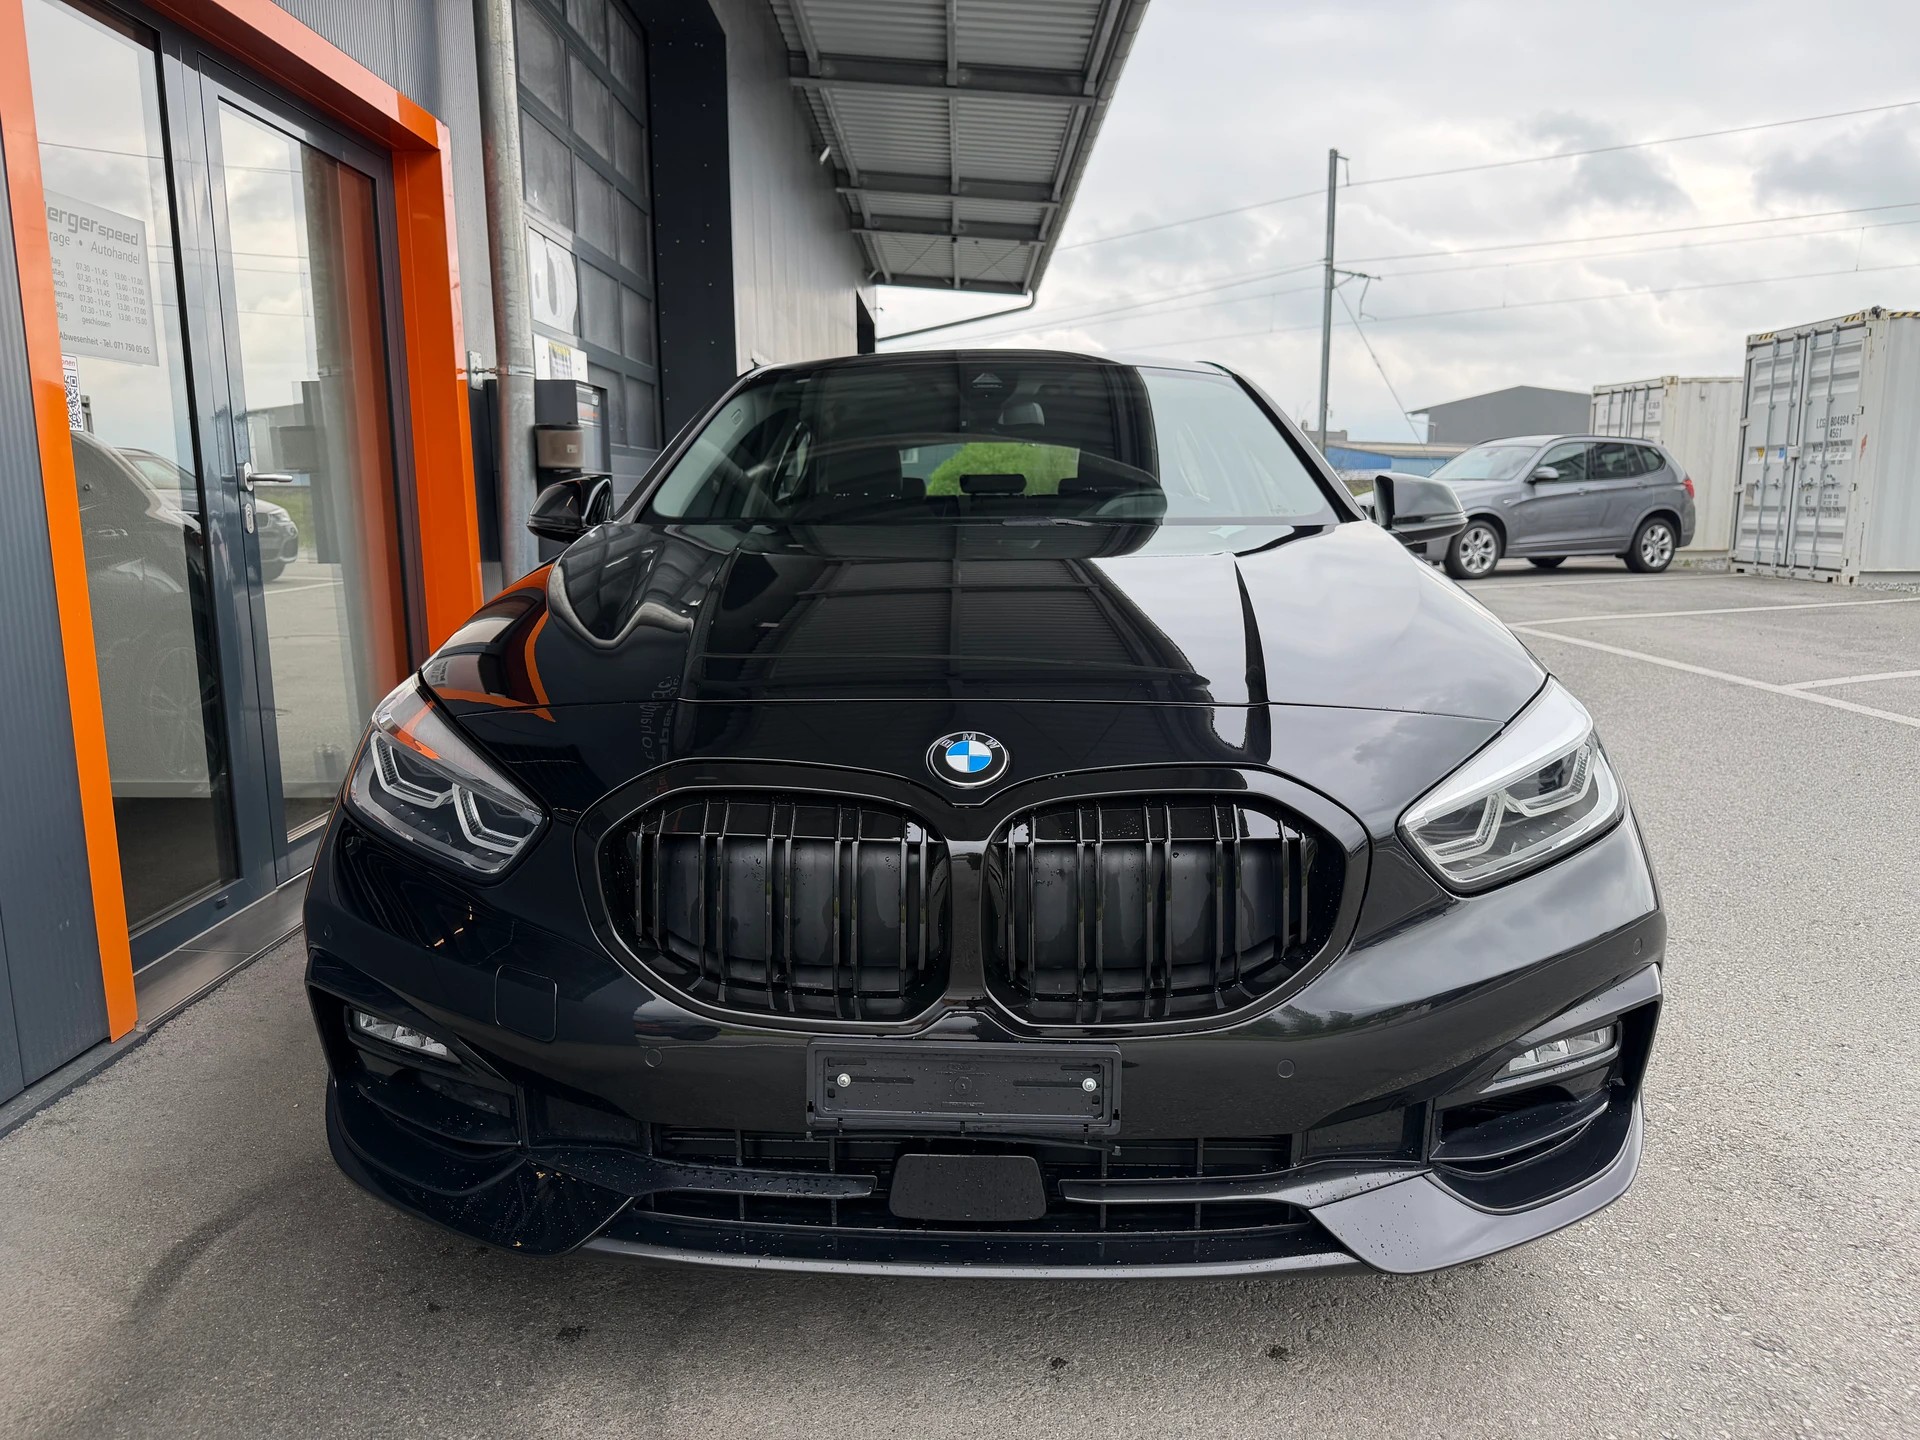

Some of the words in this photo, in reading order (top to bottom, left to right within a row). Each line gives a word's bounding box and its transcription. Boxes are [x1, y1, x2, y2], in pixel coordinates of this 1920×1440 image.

[46, 205, 138, 246] ergerspeed
[49, 231, 70, 247] rage
[91, 241, 140, 265] Autohandel
[82, 317, 111, 328] geschlossen
[114, 341, 124, 350] 071
[940, 732, 1001, 749] BMW
